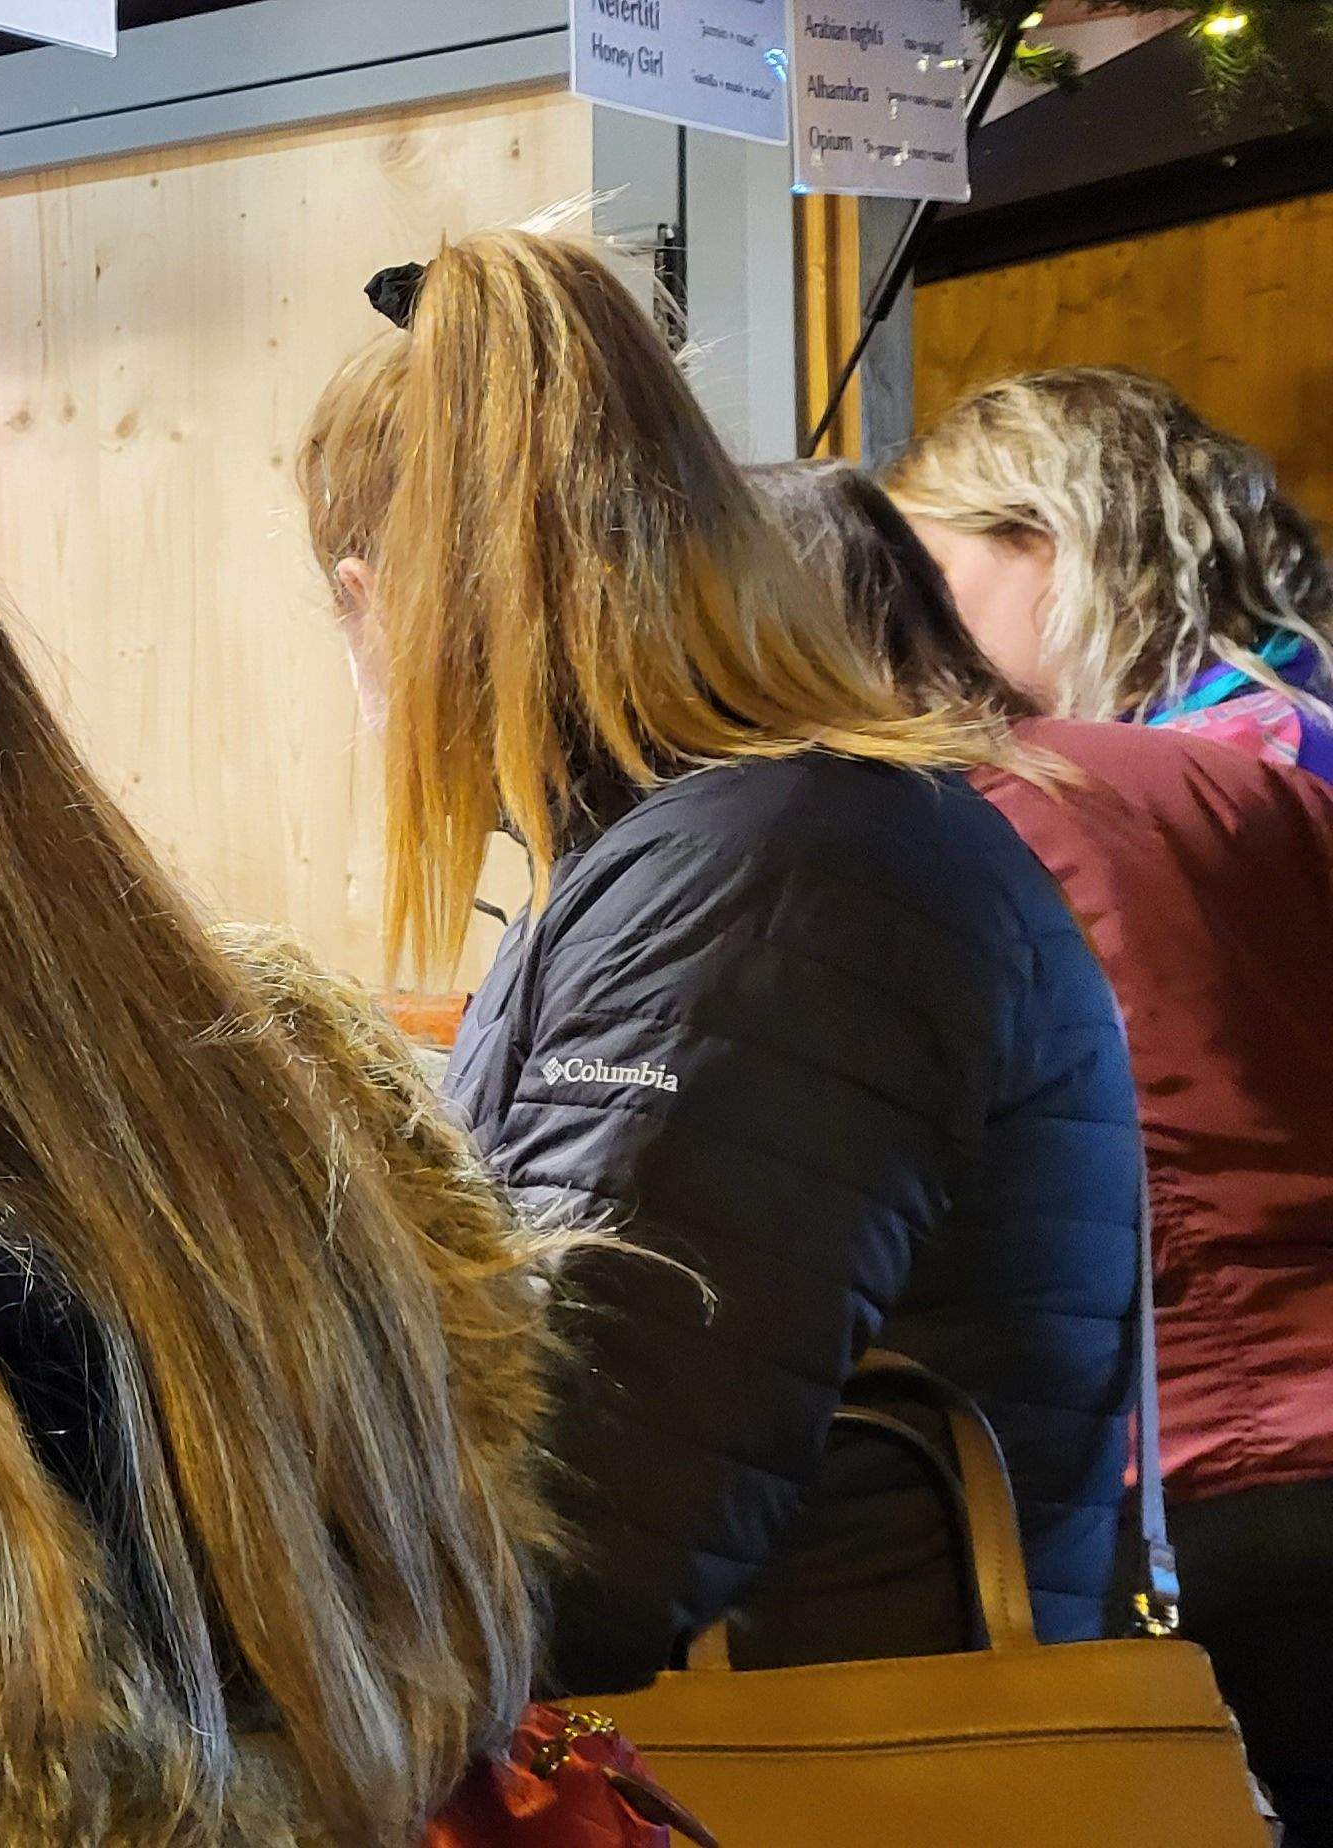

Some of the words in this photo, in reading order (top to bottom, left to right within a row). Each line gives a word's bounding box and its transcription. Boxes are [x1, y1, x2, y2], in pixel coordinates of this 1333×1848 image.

[805, 14, 849, 41] Arabian
[591, 32, 634, 78] Honey
[638, 46, 664, 78] Girl
[807, 75, 870, 102] Alhambra
[809, 126, 853, 158] Opium
[563, 1058, 679, 1092] Columbia
